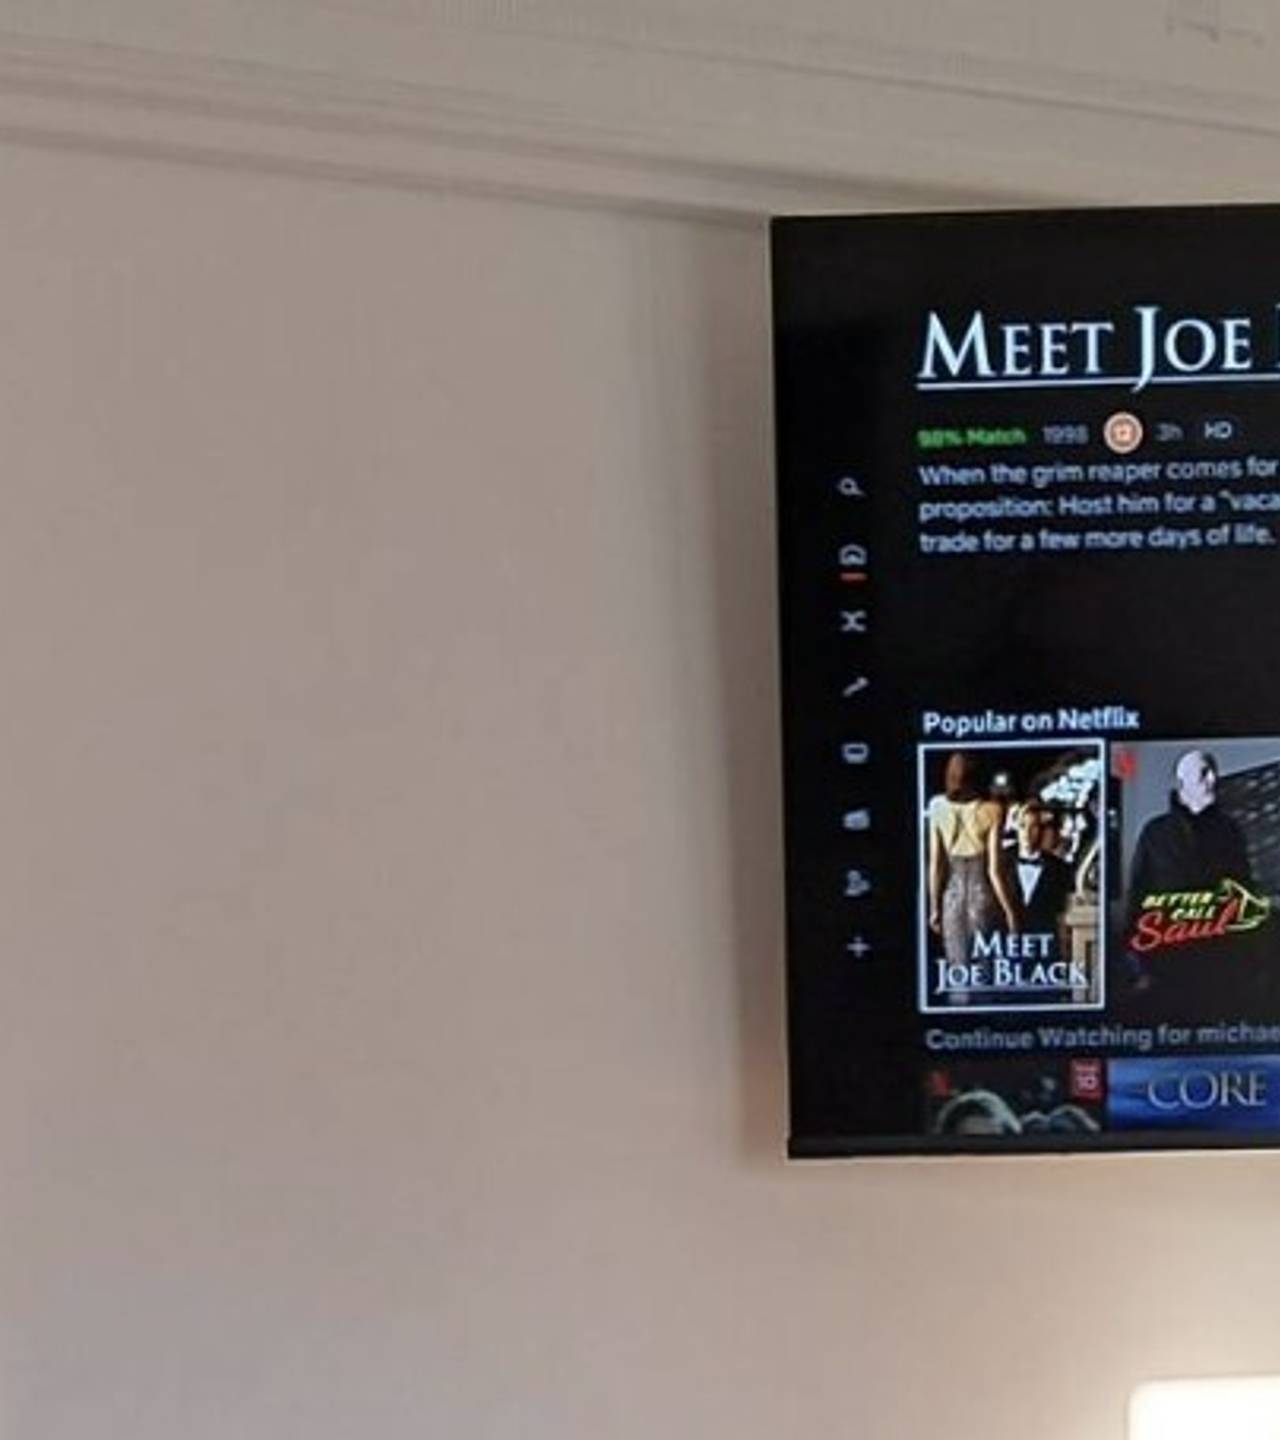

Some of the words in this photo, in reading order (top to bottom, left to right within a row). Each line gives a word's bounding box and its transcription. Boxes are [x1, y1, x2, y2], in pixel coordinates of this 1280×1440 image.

[920, 310, 1114, 378] MEET
[1132, 306, 1253, 392] JOE
[967, 427, 1027, 446] Match
[1204, 420, 1233, 439] HD
[919, 465, 985, 486] When
[990, 463, 1028, 484] the
[1031, 462, 1084, 488] grim
[1087, 463, 1161, 485] reaper
[1166, 461, 1243, 480] comes
[1246, 456, 1279, 477] for
[919, 496, 1055, 522] proposition:
[1059, 495, 1114, 516] Host
[1117, 493, 1160, 515] him
[1165, 492, 1195, 513] for
[1200, 495, 1216, 512] a
[919, 531, 980, 553] trade
[983, 529, 1016, 551] for
[1020, 533, 1035, 550] a
[1039, 527, 1080, 549] few
[1085, 530, 1144, 549] more
[1148, 525, 1203, 549] days
[1206, 524, 1230, 546] of
[1234, 522, 1277, 545] life.
[923, 711, 1017, 738] Popular
[1021, 713, 1055, 733] on
[1057, 707, 1140, 732] Netflix
[1131, 898, 1239, 950] Saul
[971, 930, 1054, 958] MEET
[934, 958, 984, 994] JOE
[993, 958, 1089, 986] BLACK
[926, 1027, 1034, 1050] Continue
[1037, 1024, 1152, 1050] Watching
[1157, 1023, 1191, 1045] for
[1147, 1070, 1267, 1110] CORE
